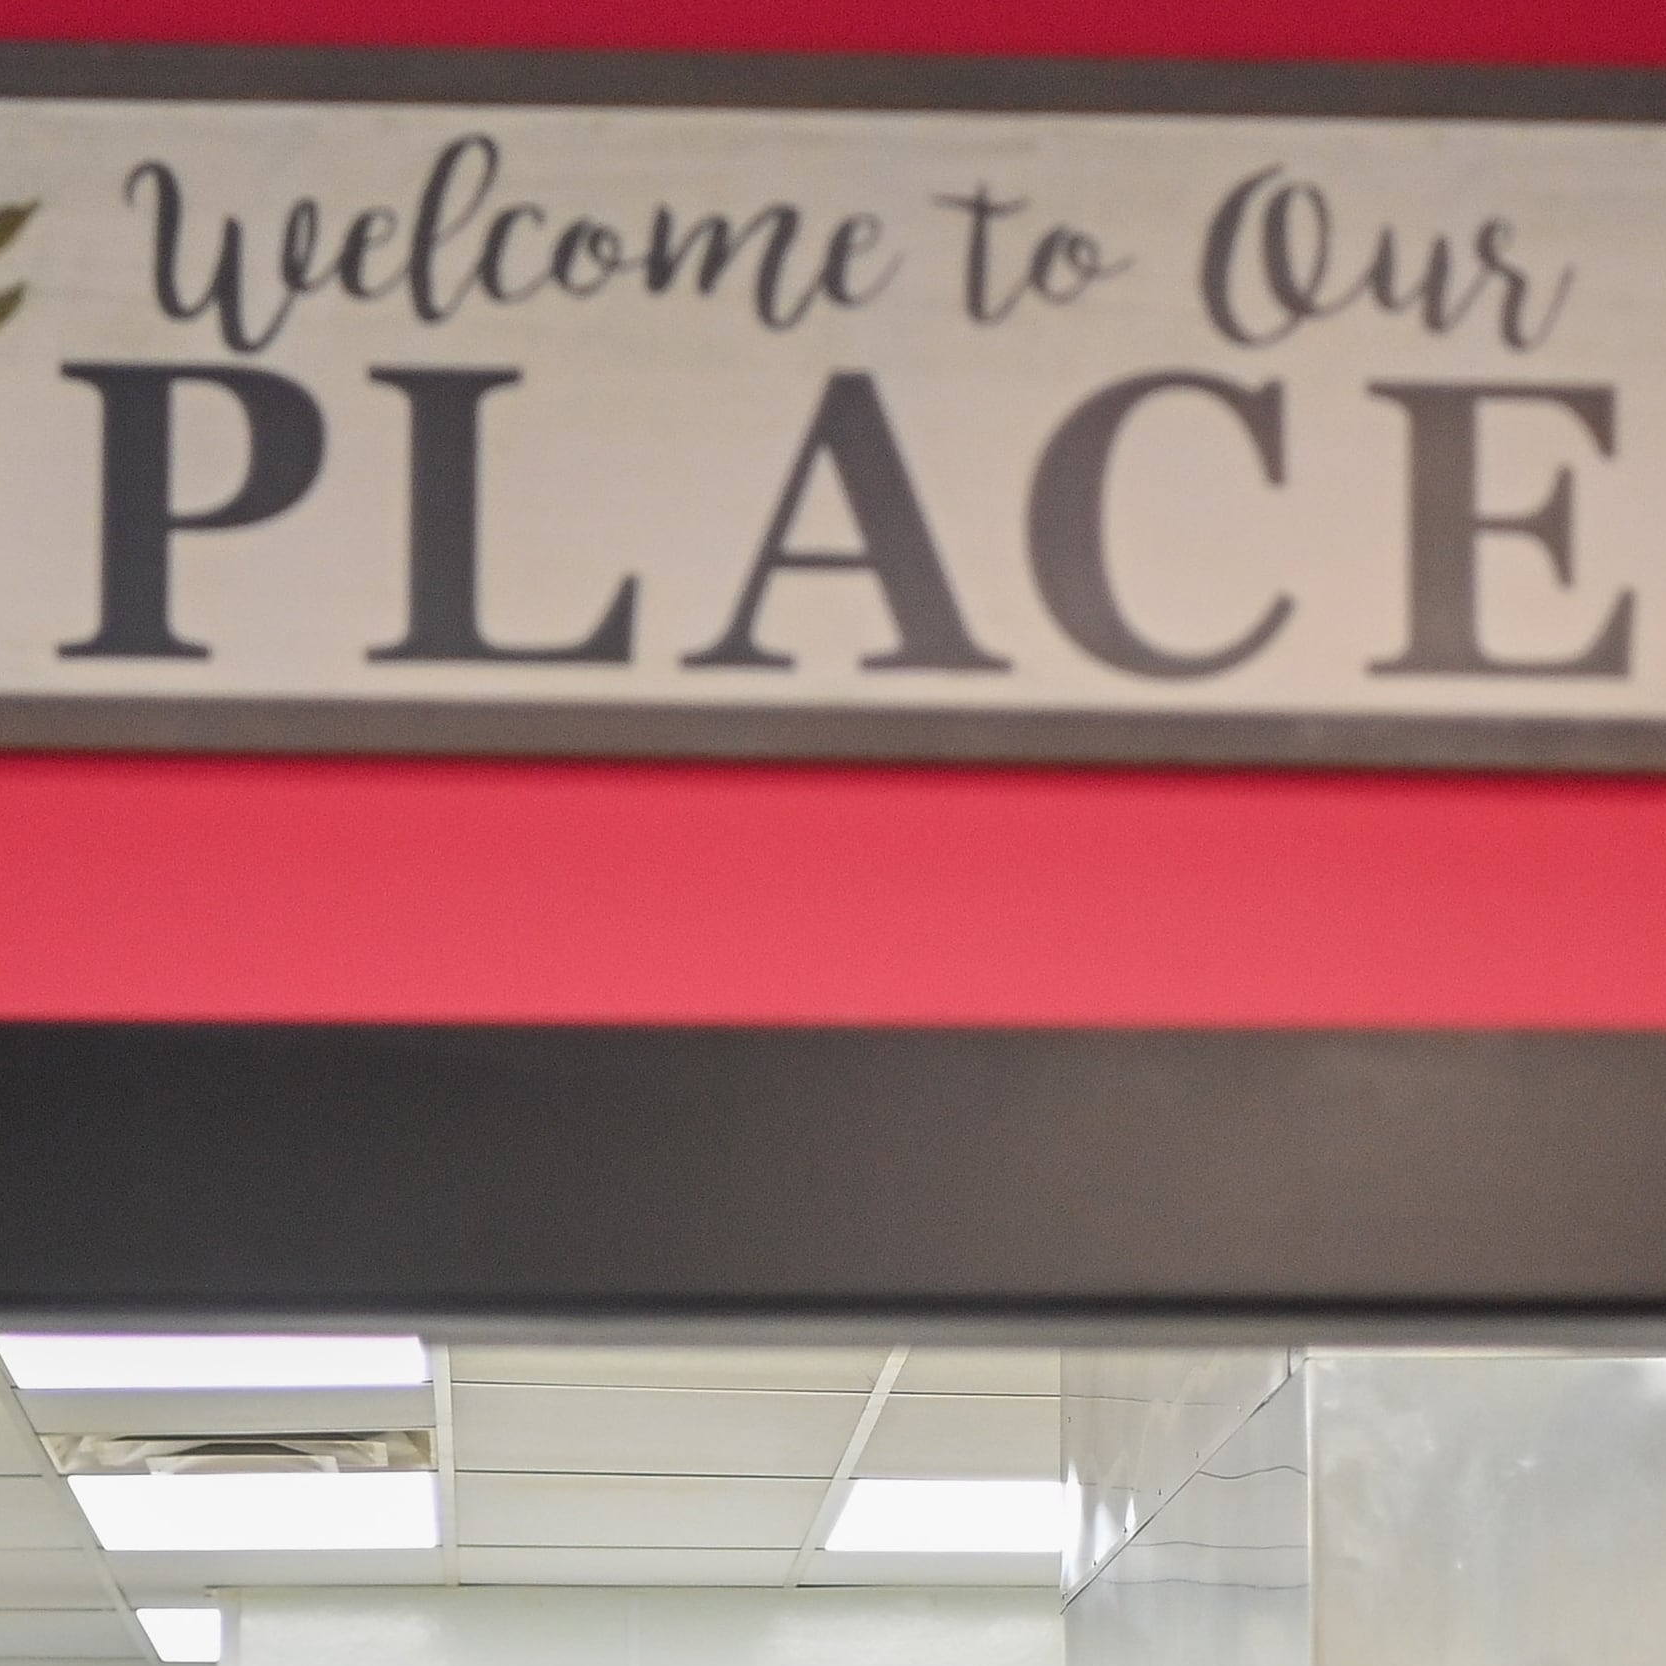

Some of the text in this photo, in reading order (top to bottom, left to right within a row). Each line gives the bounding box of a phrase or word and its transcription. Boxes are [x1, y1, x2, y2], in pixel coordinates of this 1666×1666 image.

[123, 136, 1578, 359] Welcome to Our
[58, 358, 1638, 681] PLACE
